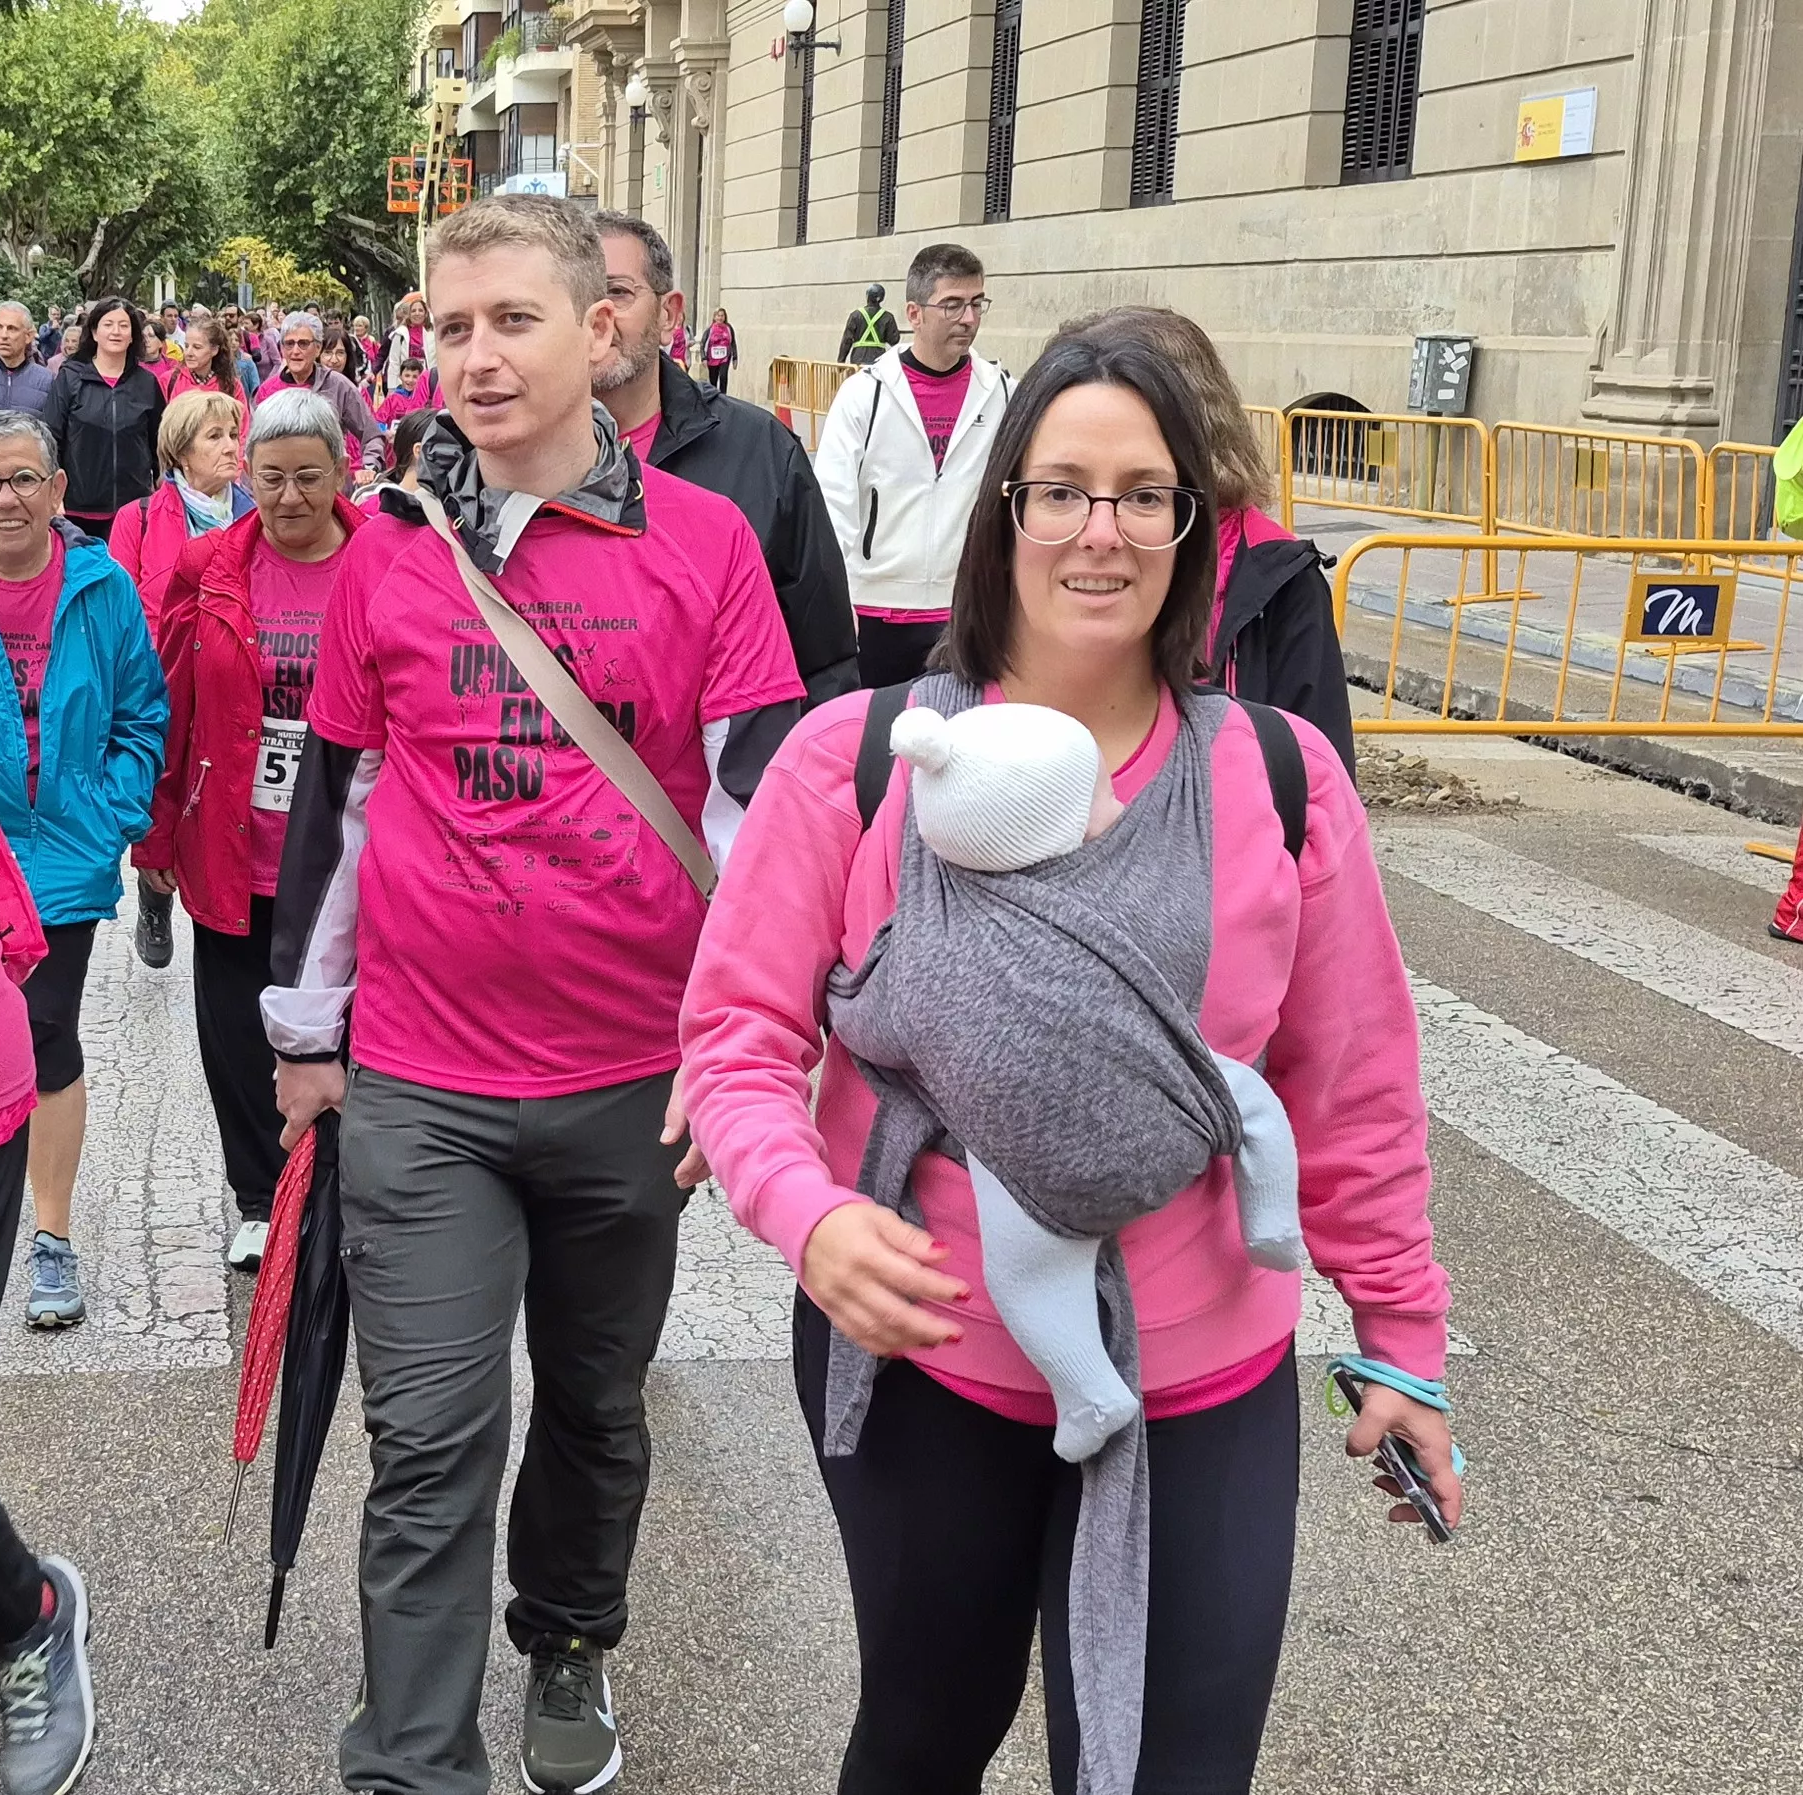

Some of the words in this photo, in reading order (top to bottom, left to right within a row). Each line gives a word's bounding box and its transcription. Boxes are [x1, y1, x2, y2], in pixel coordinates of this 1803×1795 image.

[519, 601, 584, 615] CARRERA
[450, 618, 487, 631] HUES
[561, 618, 578, 631] EL
[581, 614, 639, 631] CÁNCER
[22, 643, 34, 651] EL
[499, 697, 543, 746] EN
[286, 740, 298, 749] EL
[453, 745, 545, 801] PASO
